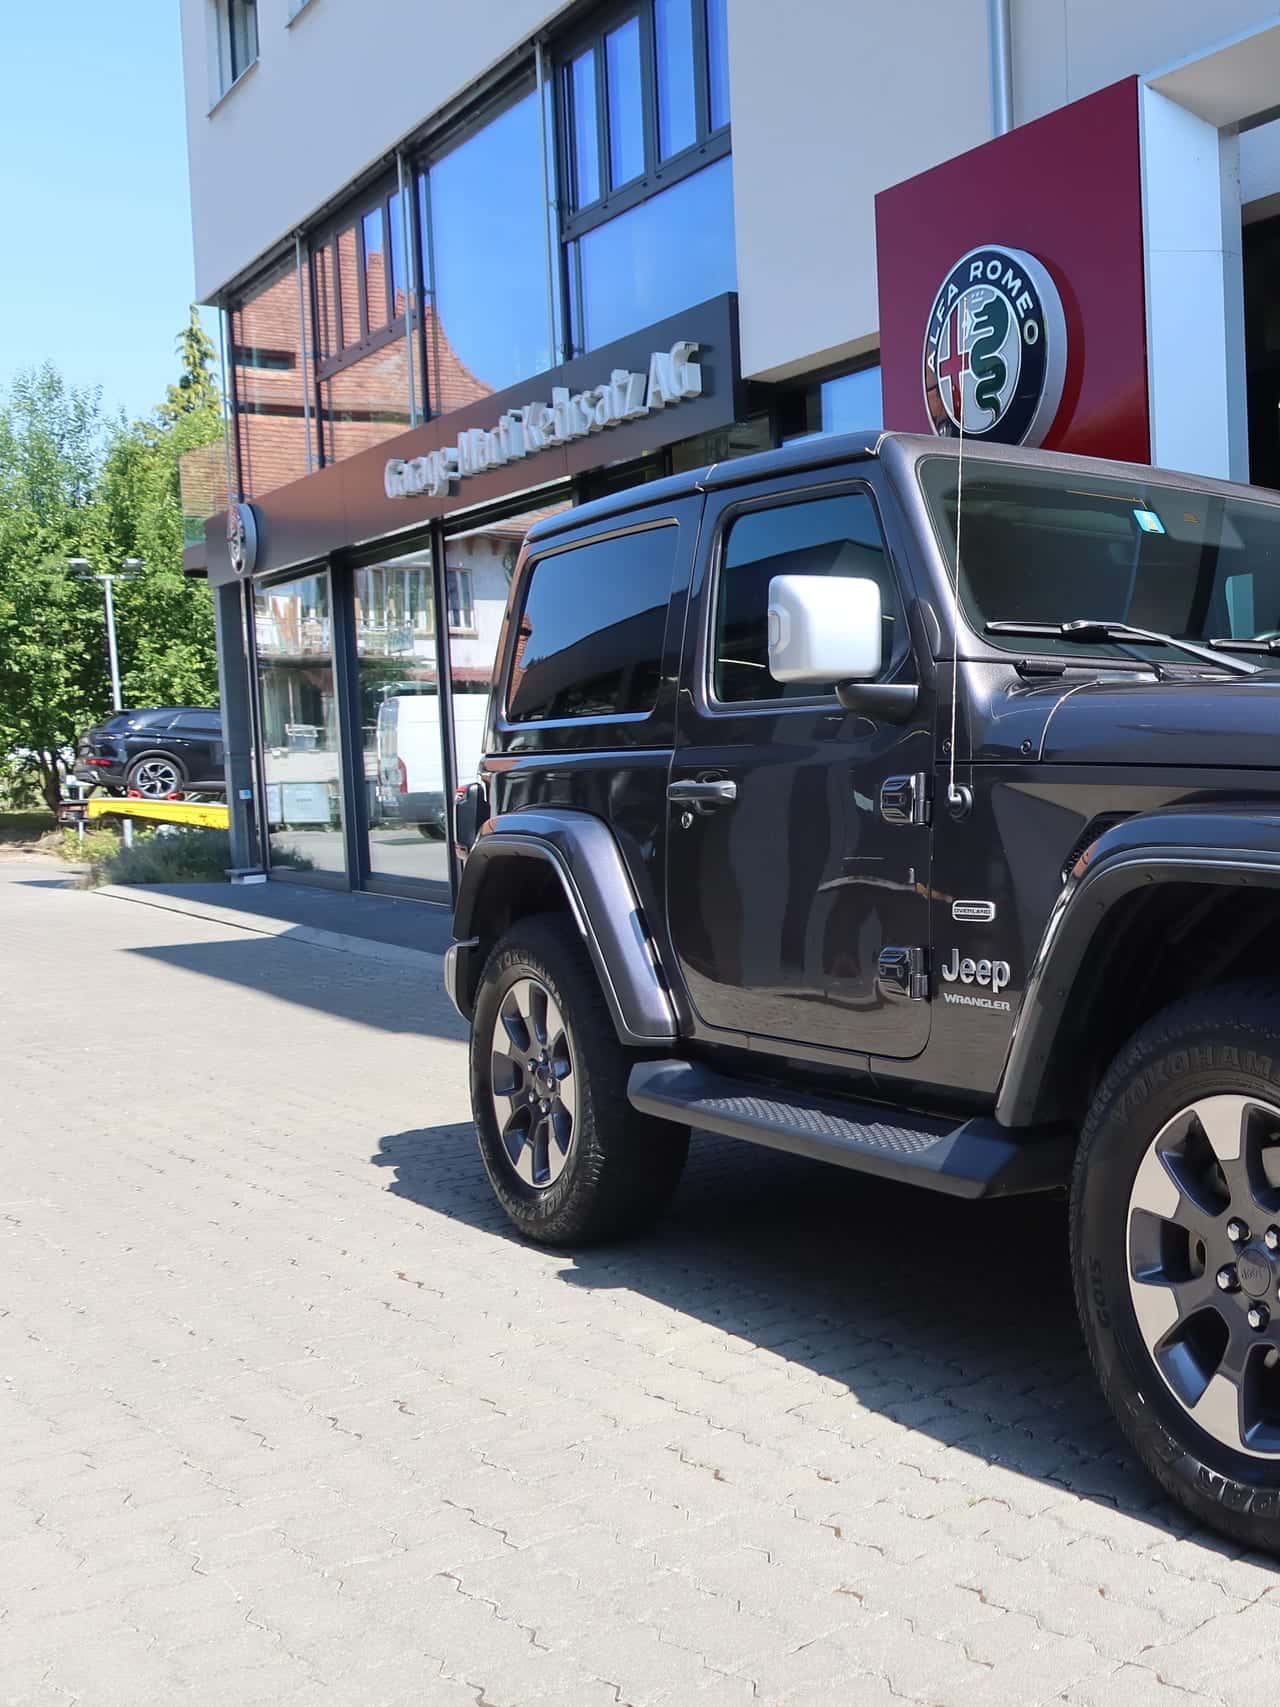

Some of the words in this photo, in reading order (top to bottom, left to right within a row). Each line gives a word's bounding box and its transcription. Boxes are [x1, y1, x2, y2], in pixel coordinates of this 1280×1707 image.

[927, 282, 960, 374] ALFA
[968, 259, 1040, 346] ROMEO
[647, 341, 703, 408] AG
[941, 948, 1011, 994] Jeep
[943, 992, 1011, 1012] WRANGLER
